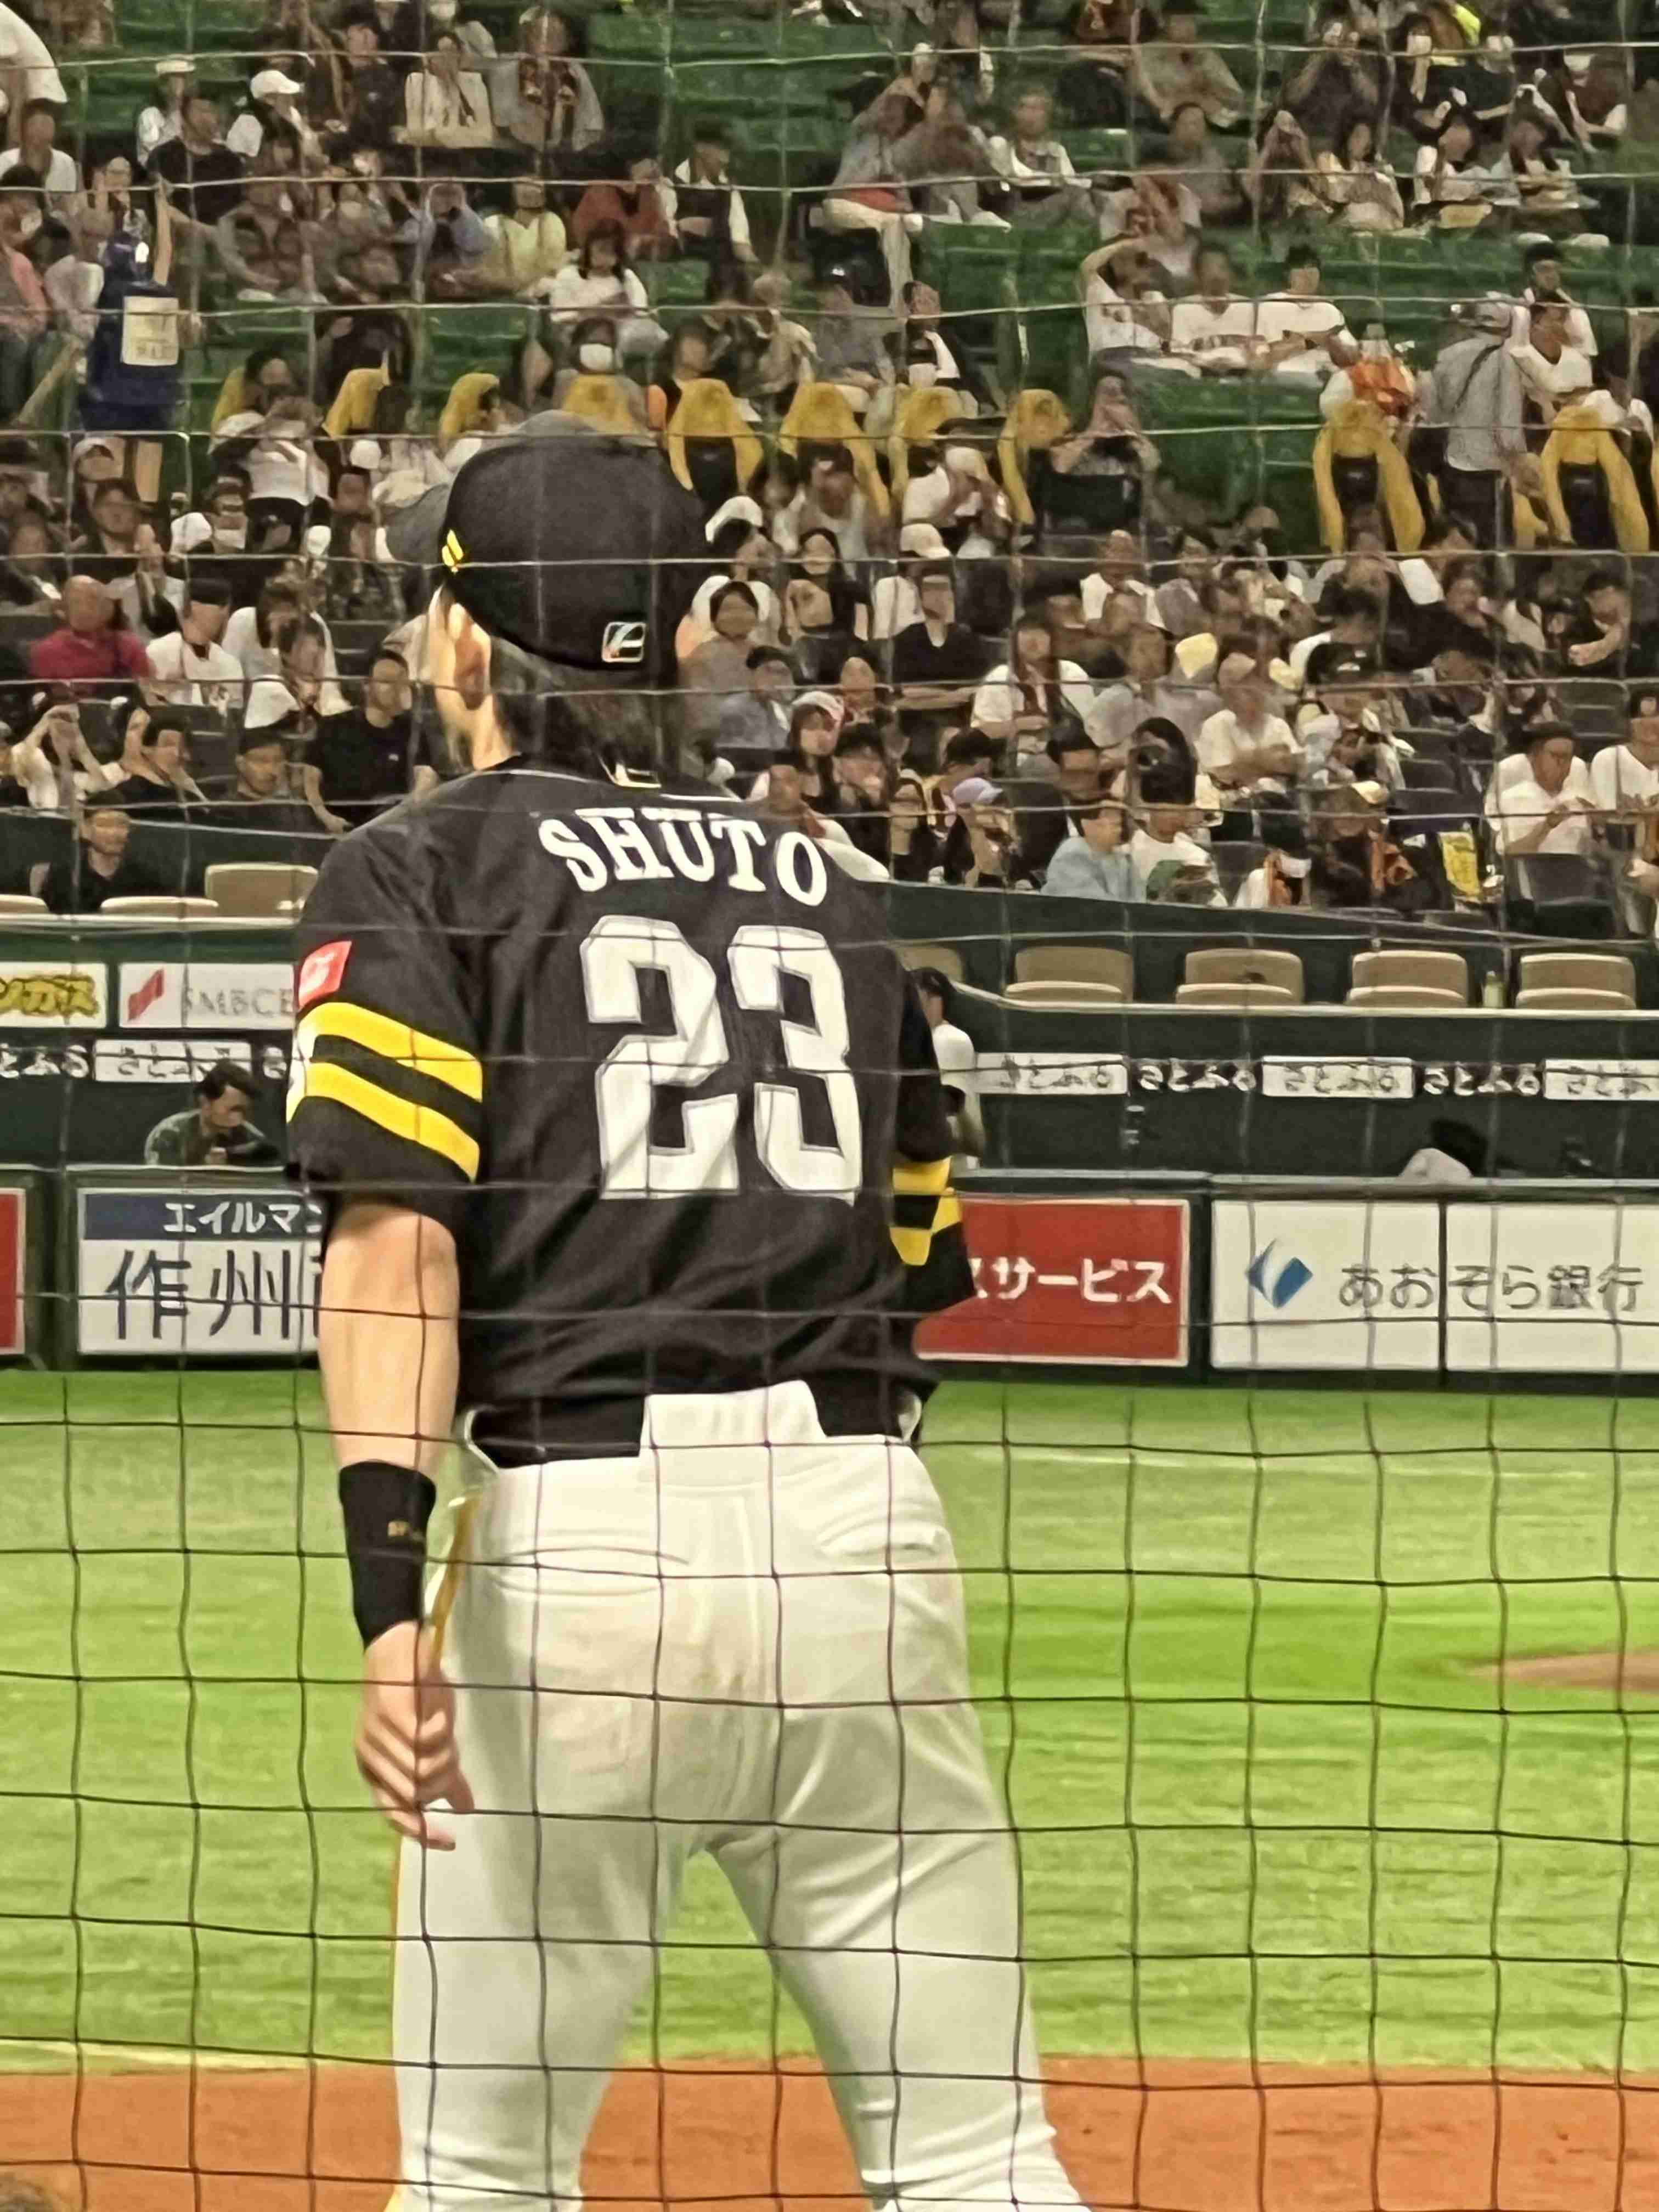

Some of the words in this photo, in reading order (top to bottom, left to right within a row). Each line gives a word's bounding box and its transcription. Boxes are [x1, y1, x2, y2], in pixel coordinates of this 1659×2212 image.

[539, 807, 828, 906] SHUTO
[579, 915, 864, 1207] 23
[105, 1249, 323, 1340] 作州
